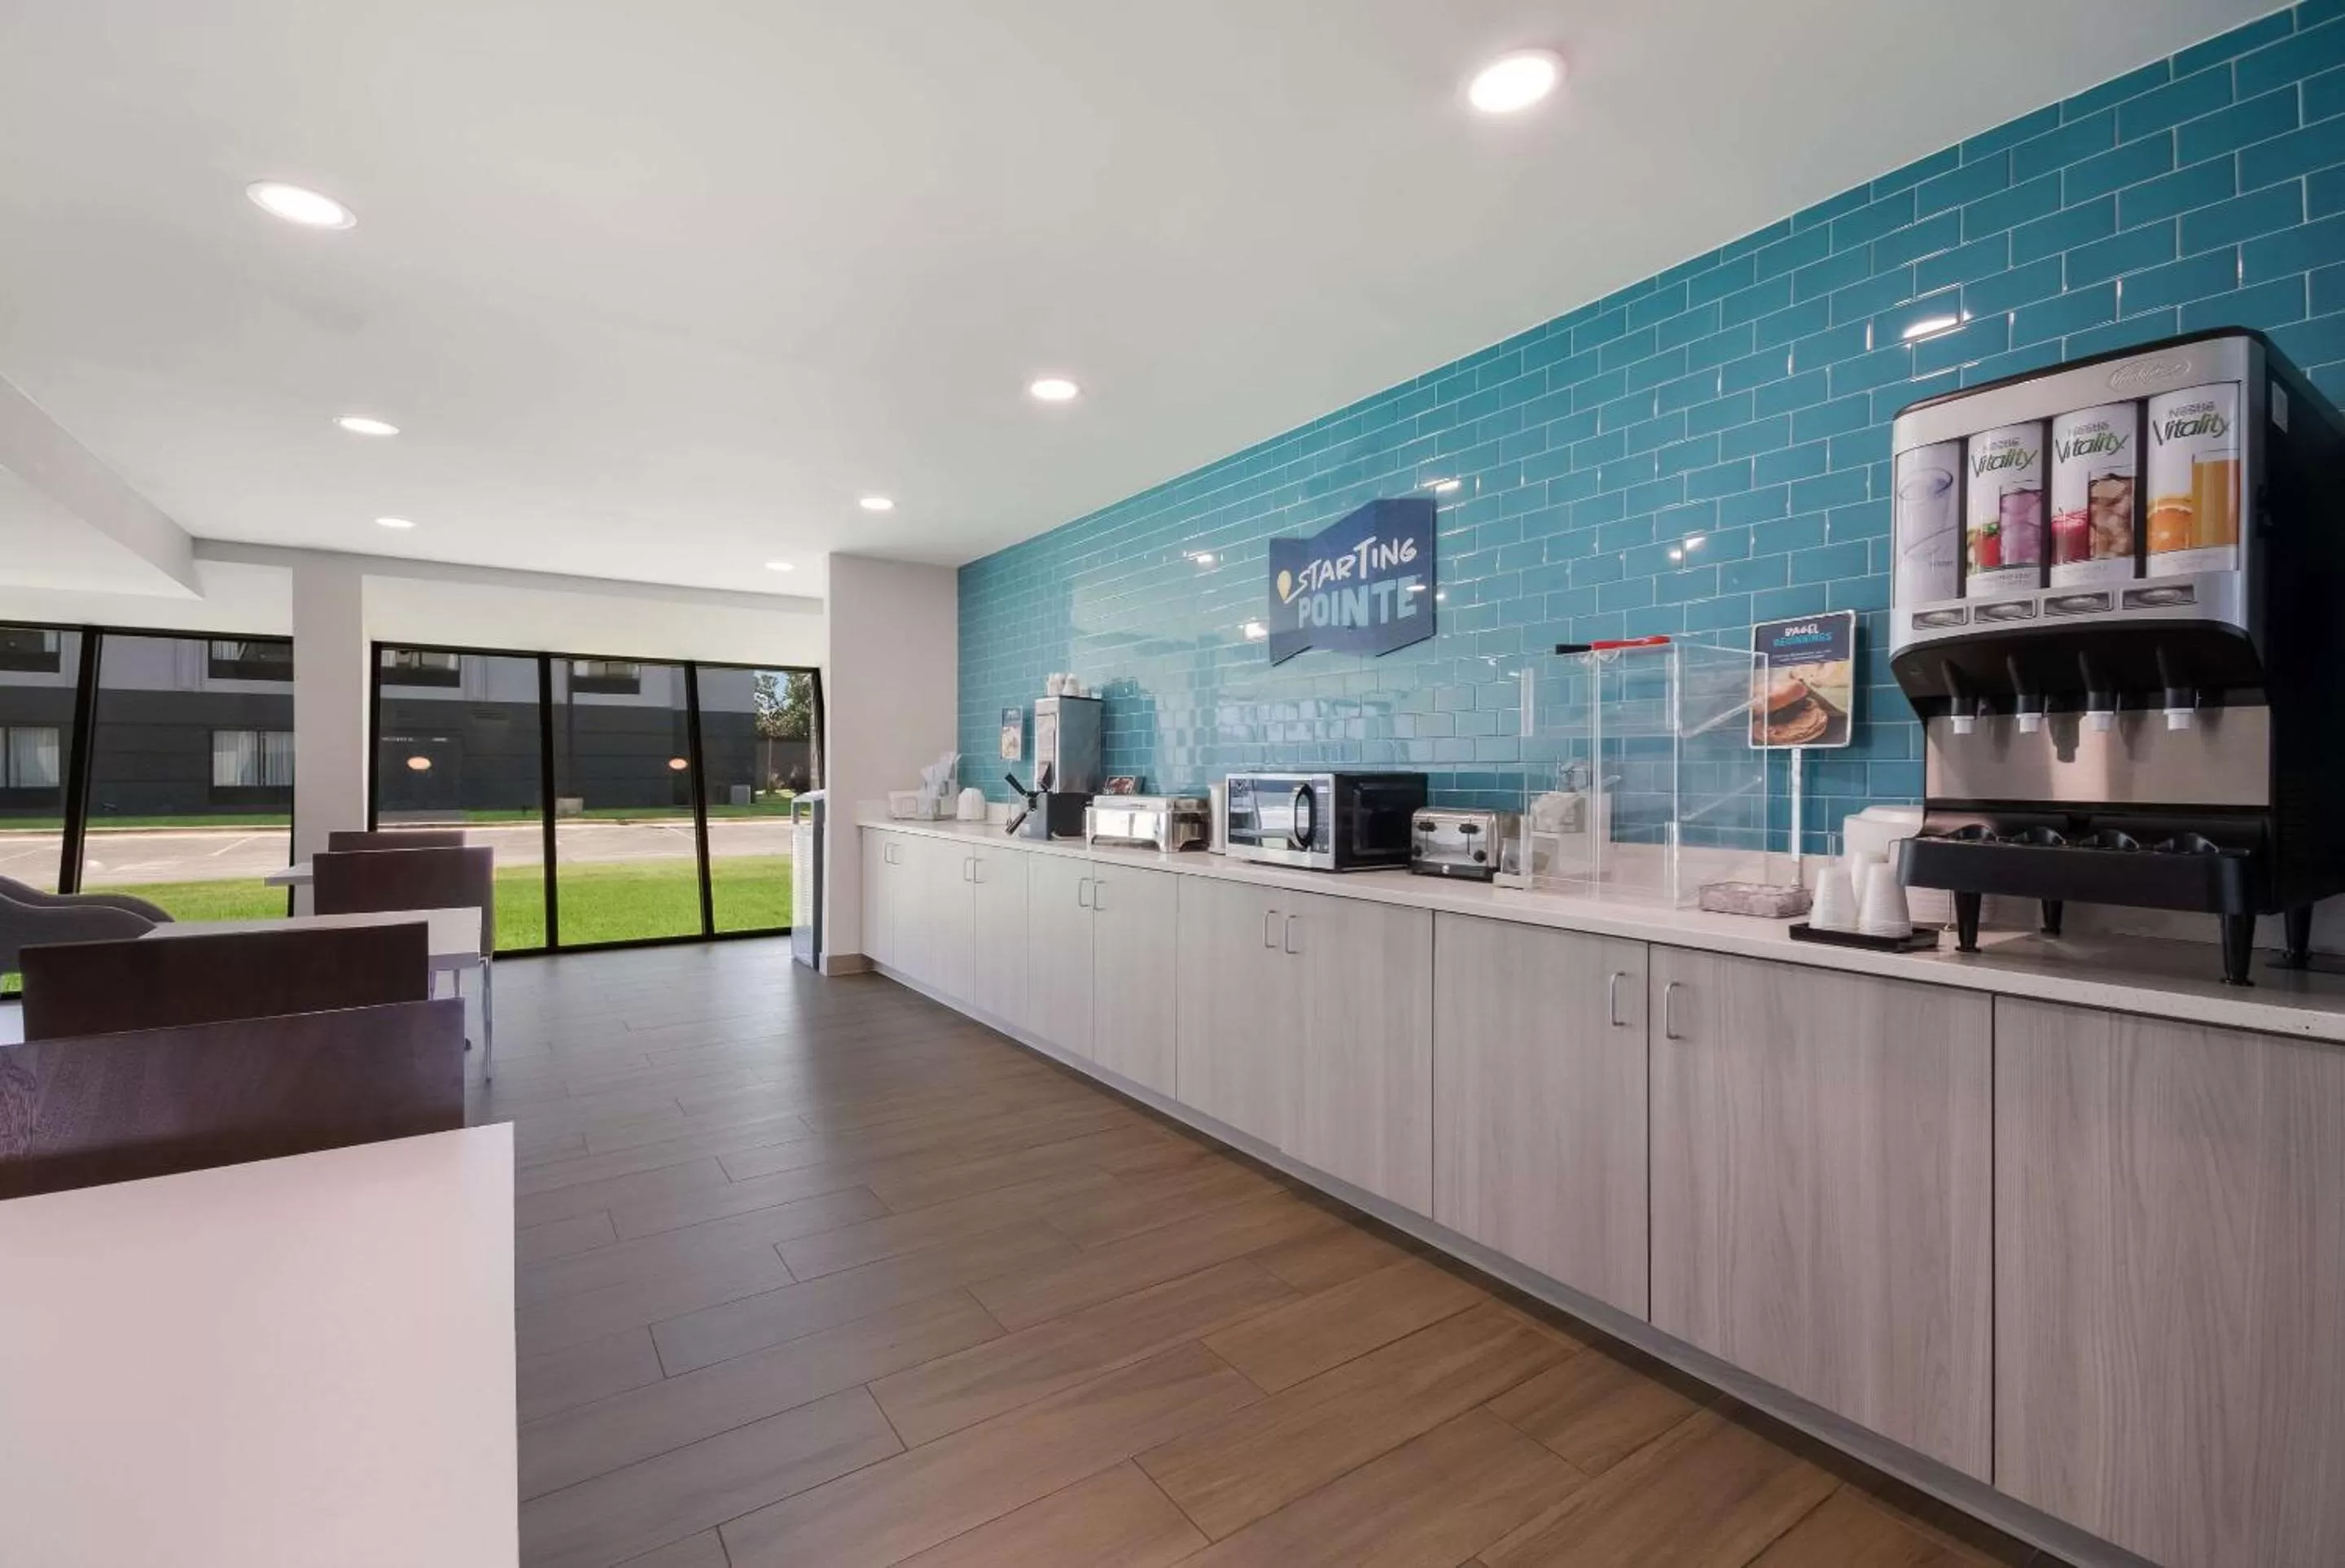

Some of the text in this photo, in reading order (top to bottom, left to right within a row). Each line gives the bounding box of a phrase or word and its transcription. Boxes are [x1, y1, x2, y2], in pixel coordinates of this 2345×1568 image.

[2152, 412, 2229, 447] Vitality
[1970, 448, 2038, 479] Vitality
[2055, 431, 2129, 464] Vitality
[1298, 536, 1418, 592] STARTING
[1298, 573, 1422, 629] POINTE
[1784, 623, 1819, 637] BAGEL
